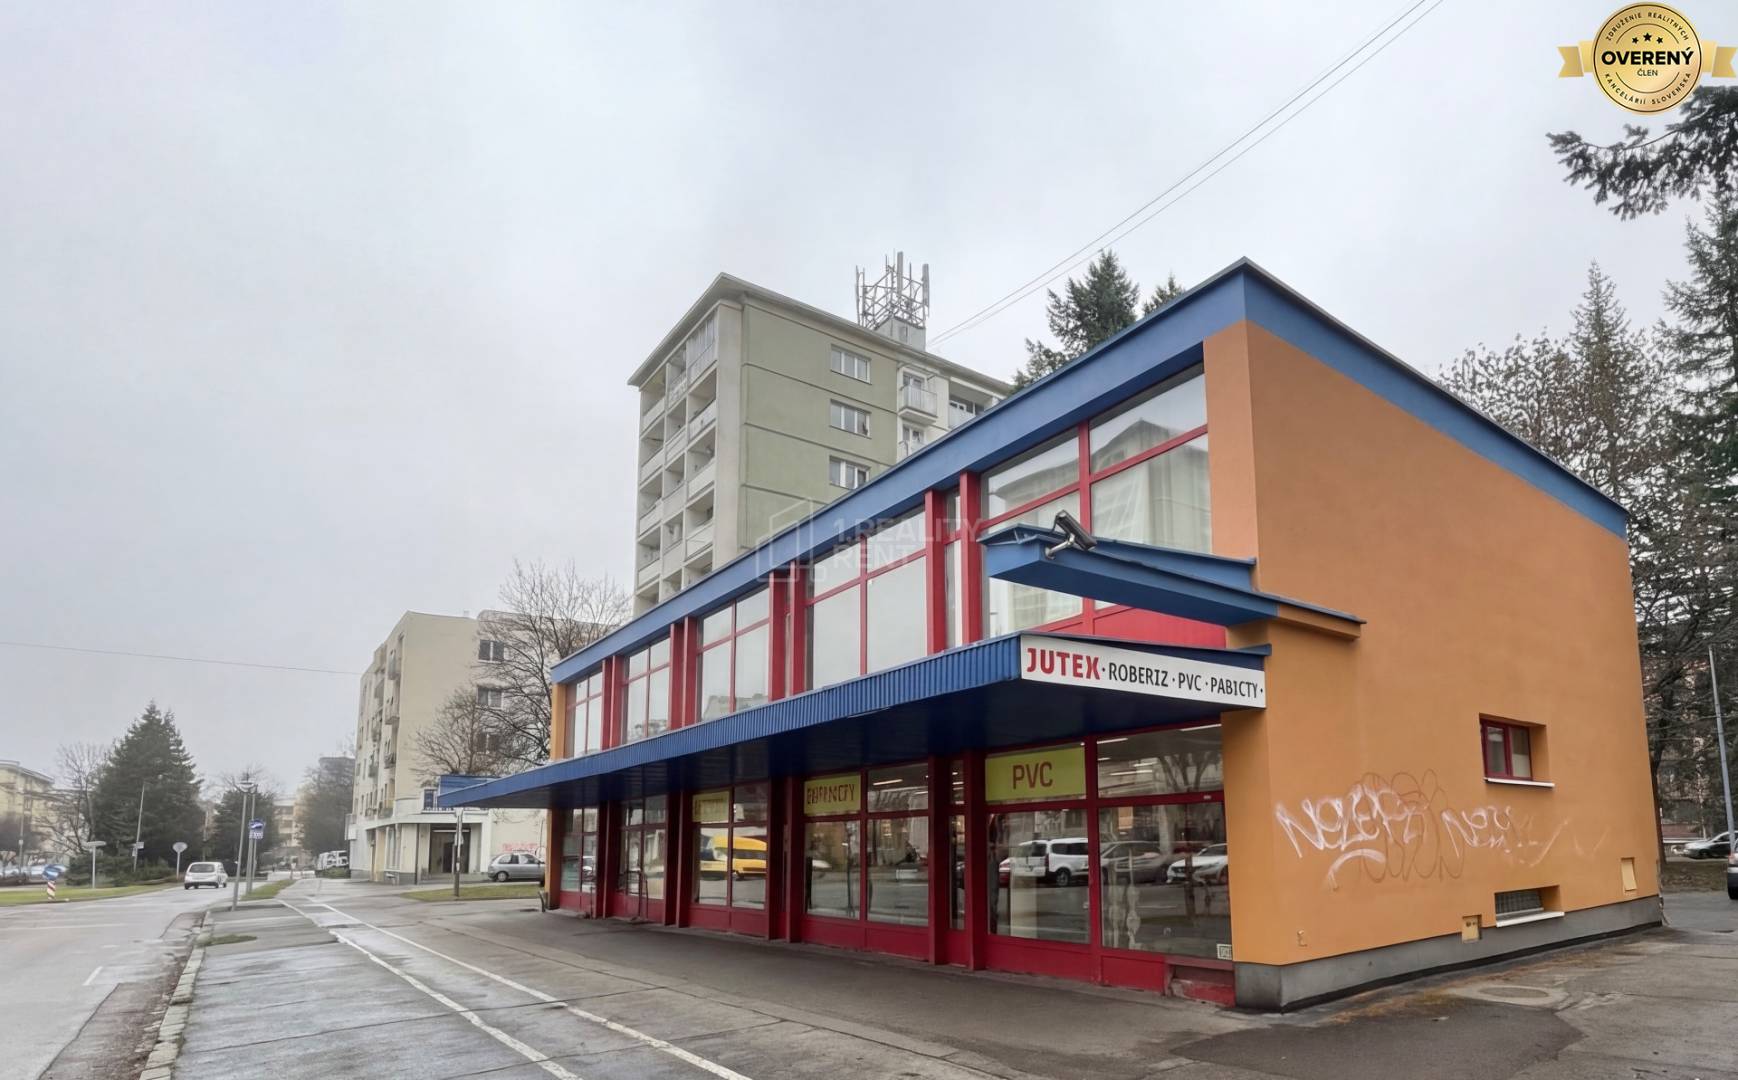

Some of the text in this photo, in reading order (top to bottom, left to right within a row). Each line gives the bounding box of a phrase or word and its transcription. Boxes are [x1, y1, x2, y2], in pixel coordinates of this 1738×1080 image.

[1026, 647, 1101, 681] JUTEX
[1178, 672, 1202, 691] PVC
[1012, 761, 1053, 790] PVC
